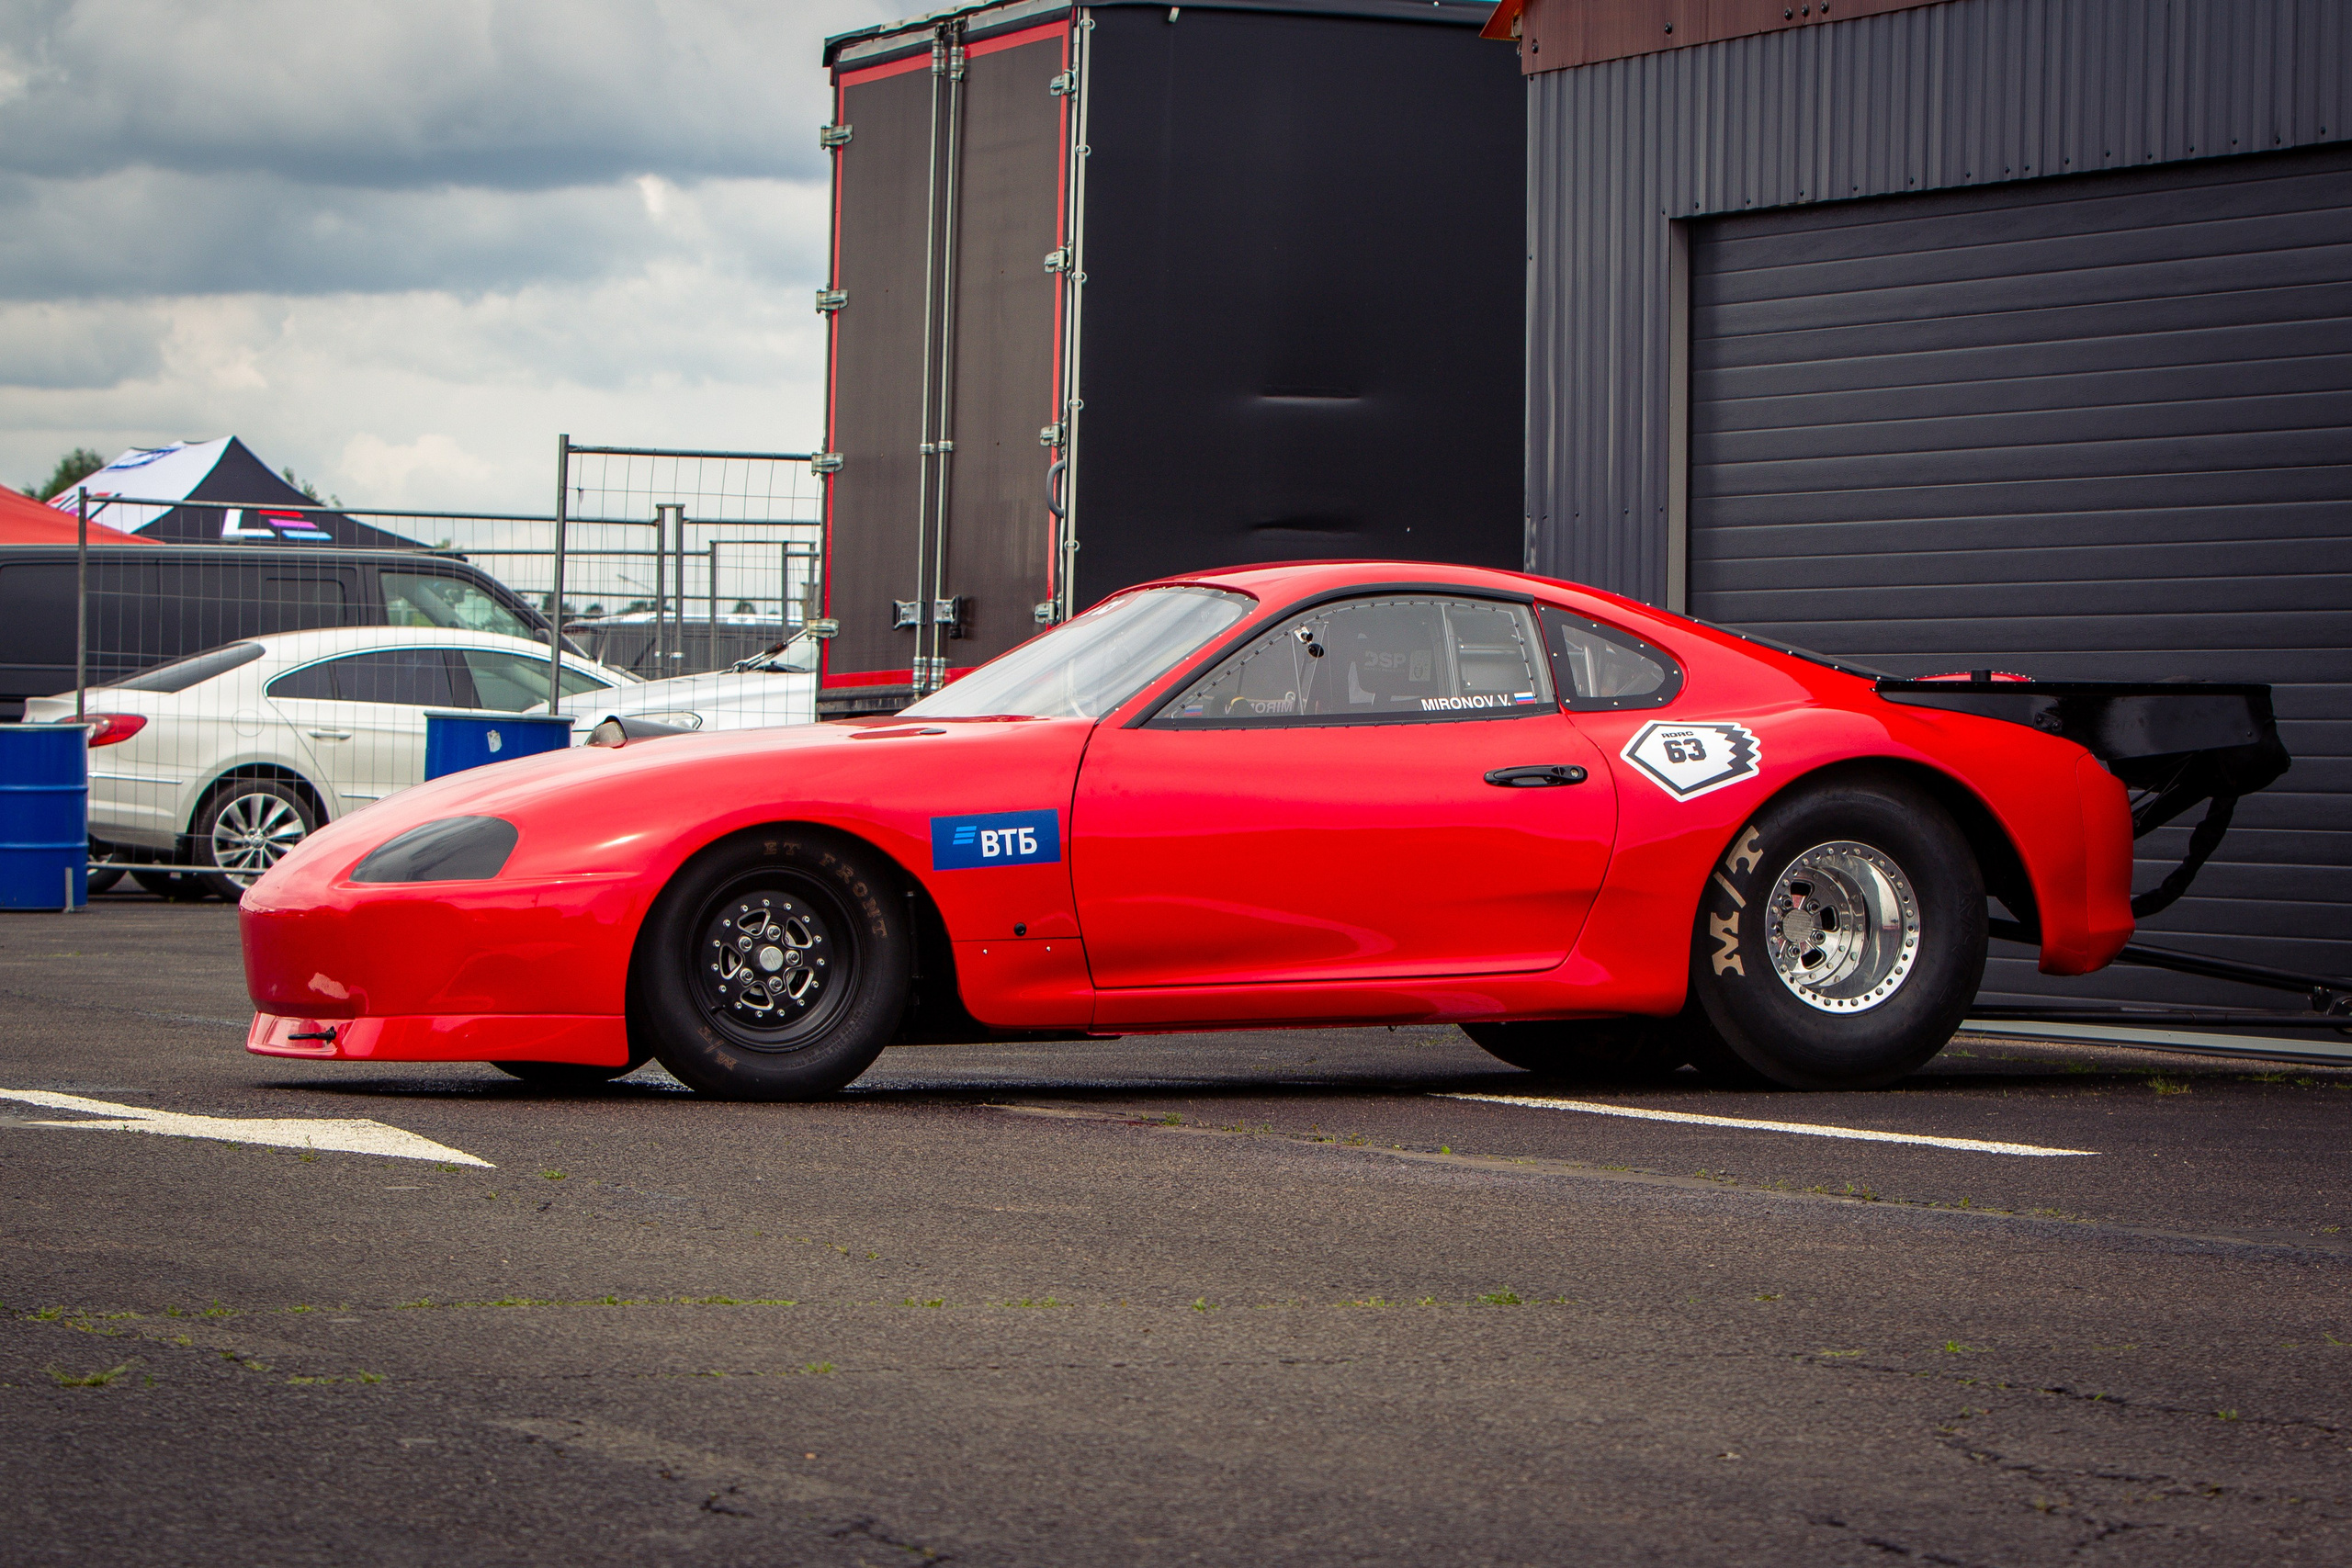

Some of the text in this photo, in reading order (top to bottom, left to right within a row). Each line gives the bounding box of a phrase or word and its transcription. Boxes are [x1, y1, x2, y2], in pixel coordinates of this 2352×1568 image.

[1420, 694, 1511, 711] MIRONOV V.
[1663, 738, 1707, 763] 63
[980, 827, 1037, 858] ВТБ
[763, 840, 888, 938] ET FRONT
[1710, 825, 1763, 976] M/T
[697, 1026, 737, 1071] M/T
